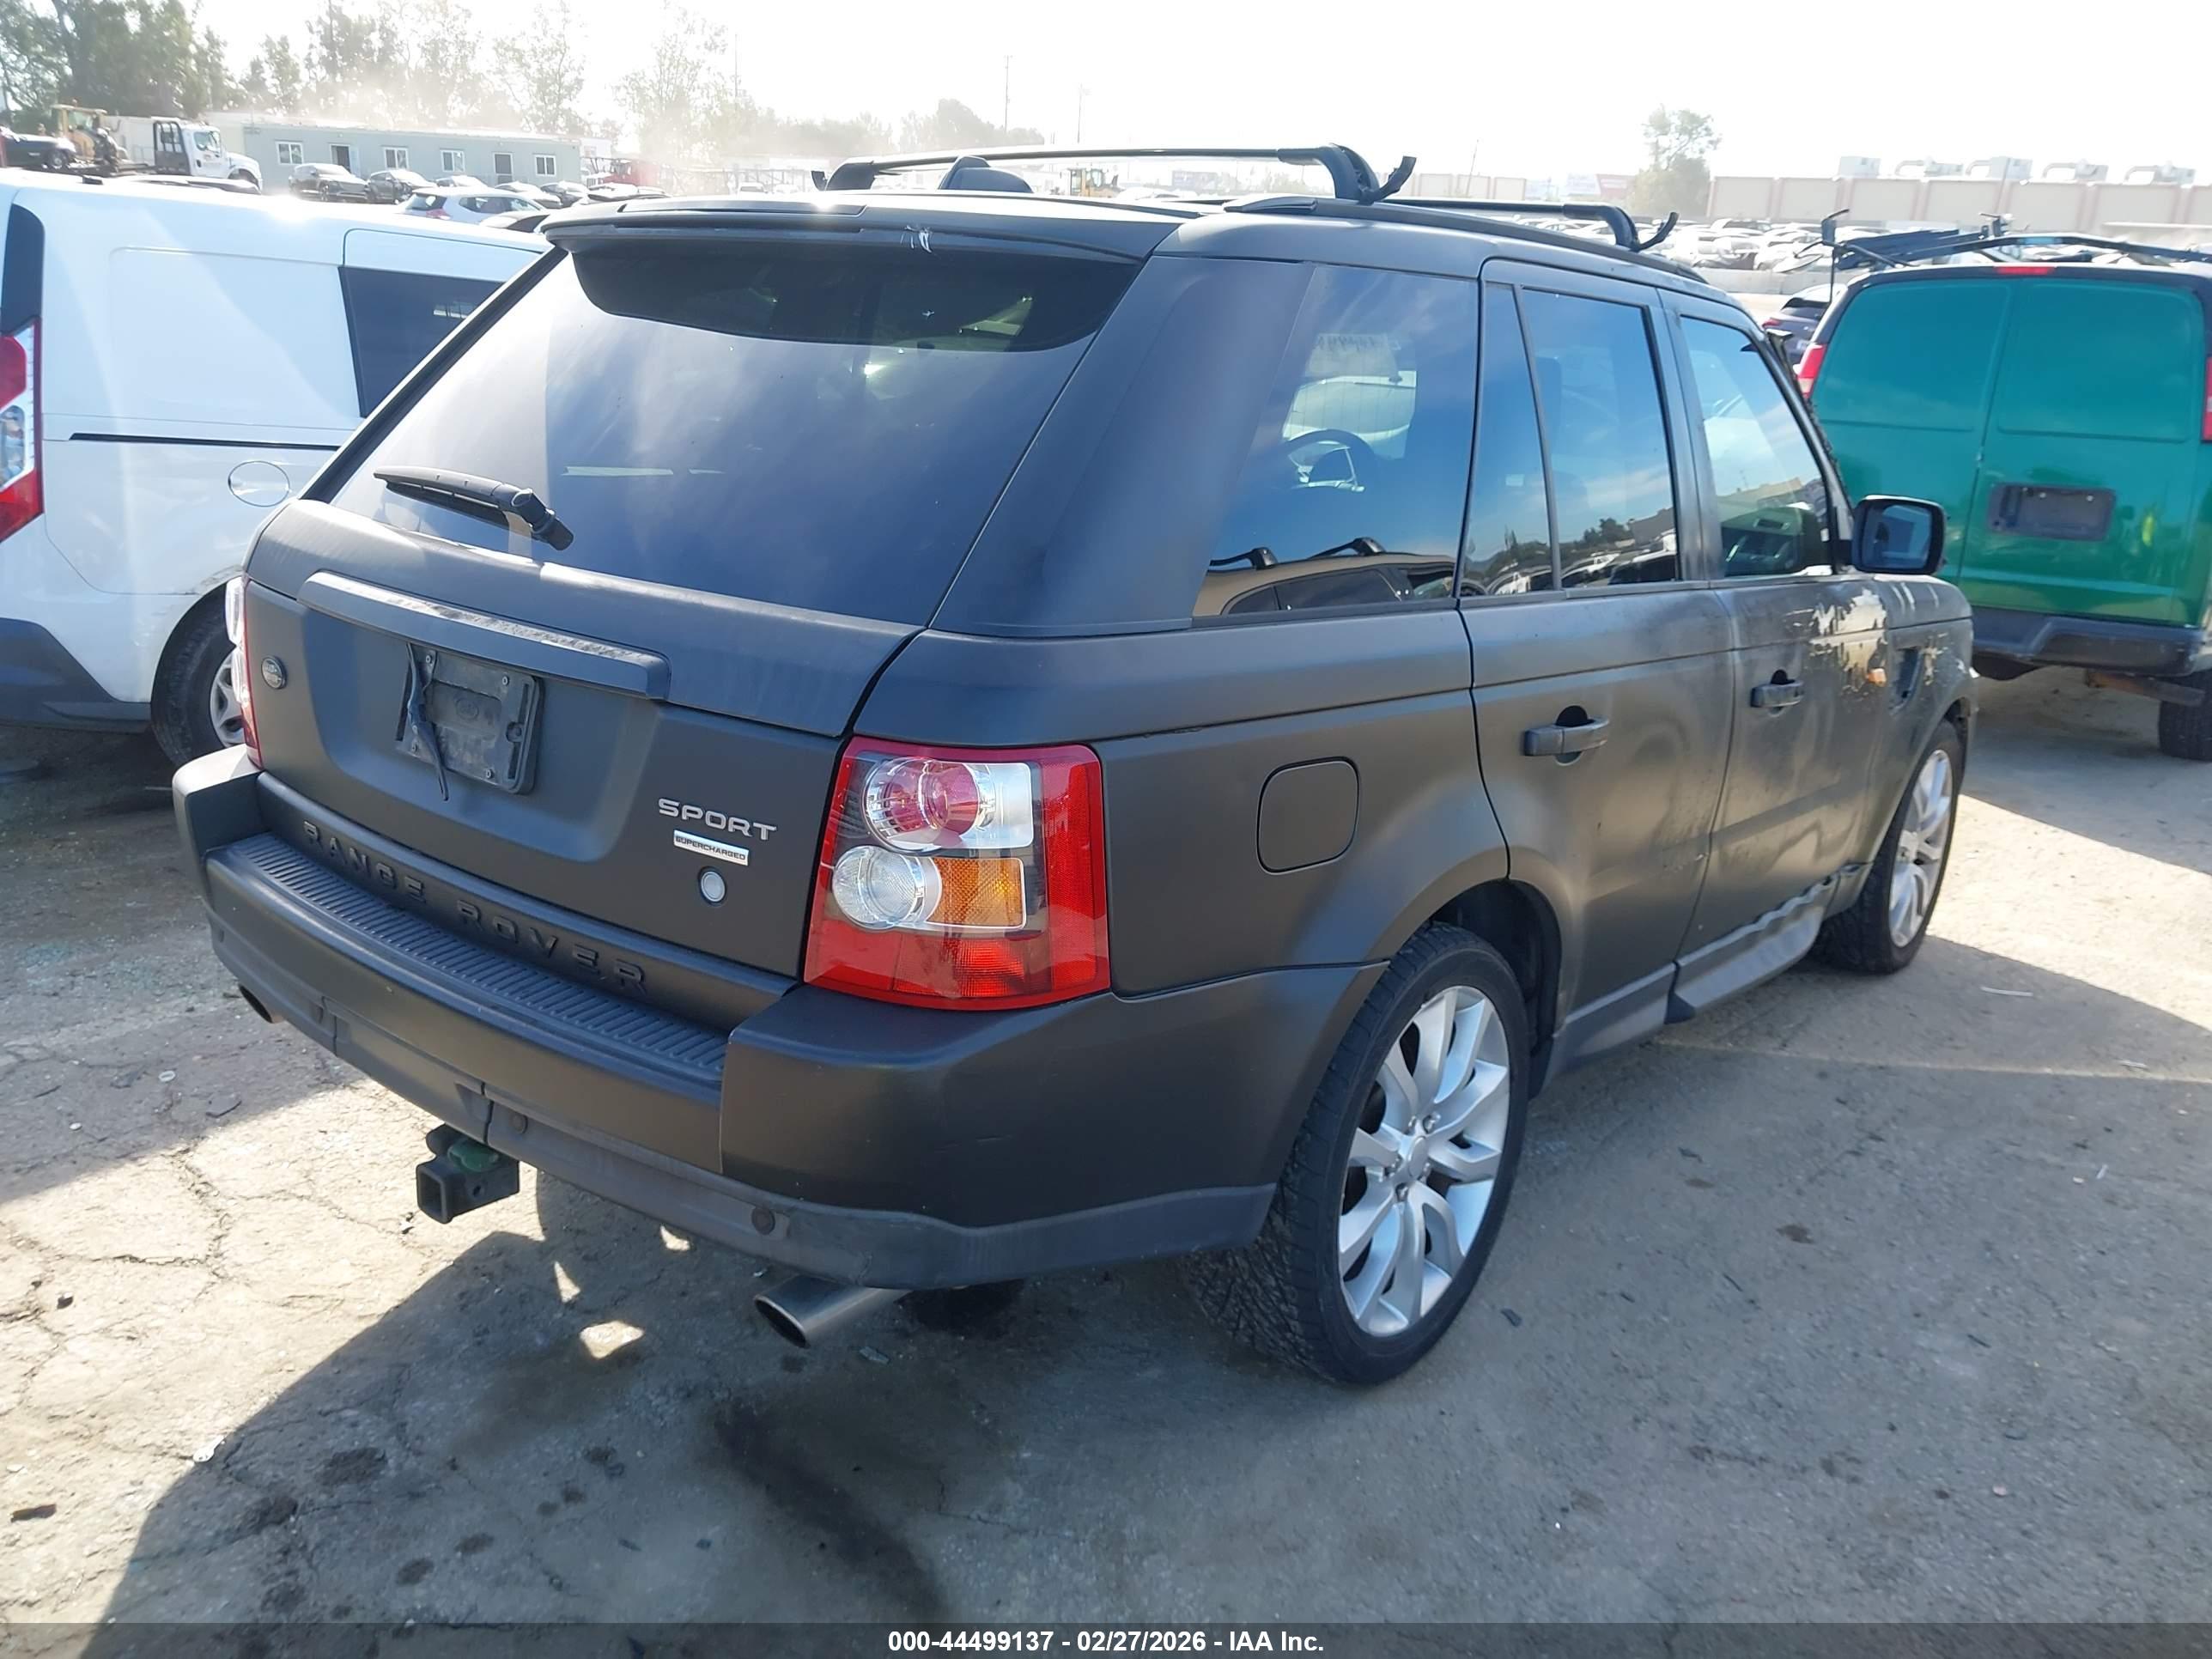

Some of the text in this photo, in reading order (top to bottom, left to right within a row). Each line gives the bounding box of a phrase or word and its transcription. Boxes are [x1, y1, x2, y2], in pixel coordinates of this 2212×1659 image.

[659, 798, 777, 841] SPORT
[675, 836, 746, 860] SUPERCHARGED
[303, 820, 647, 996] RANGE ROVER
